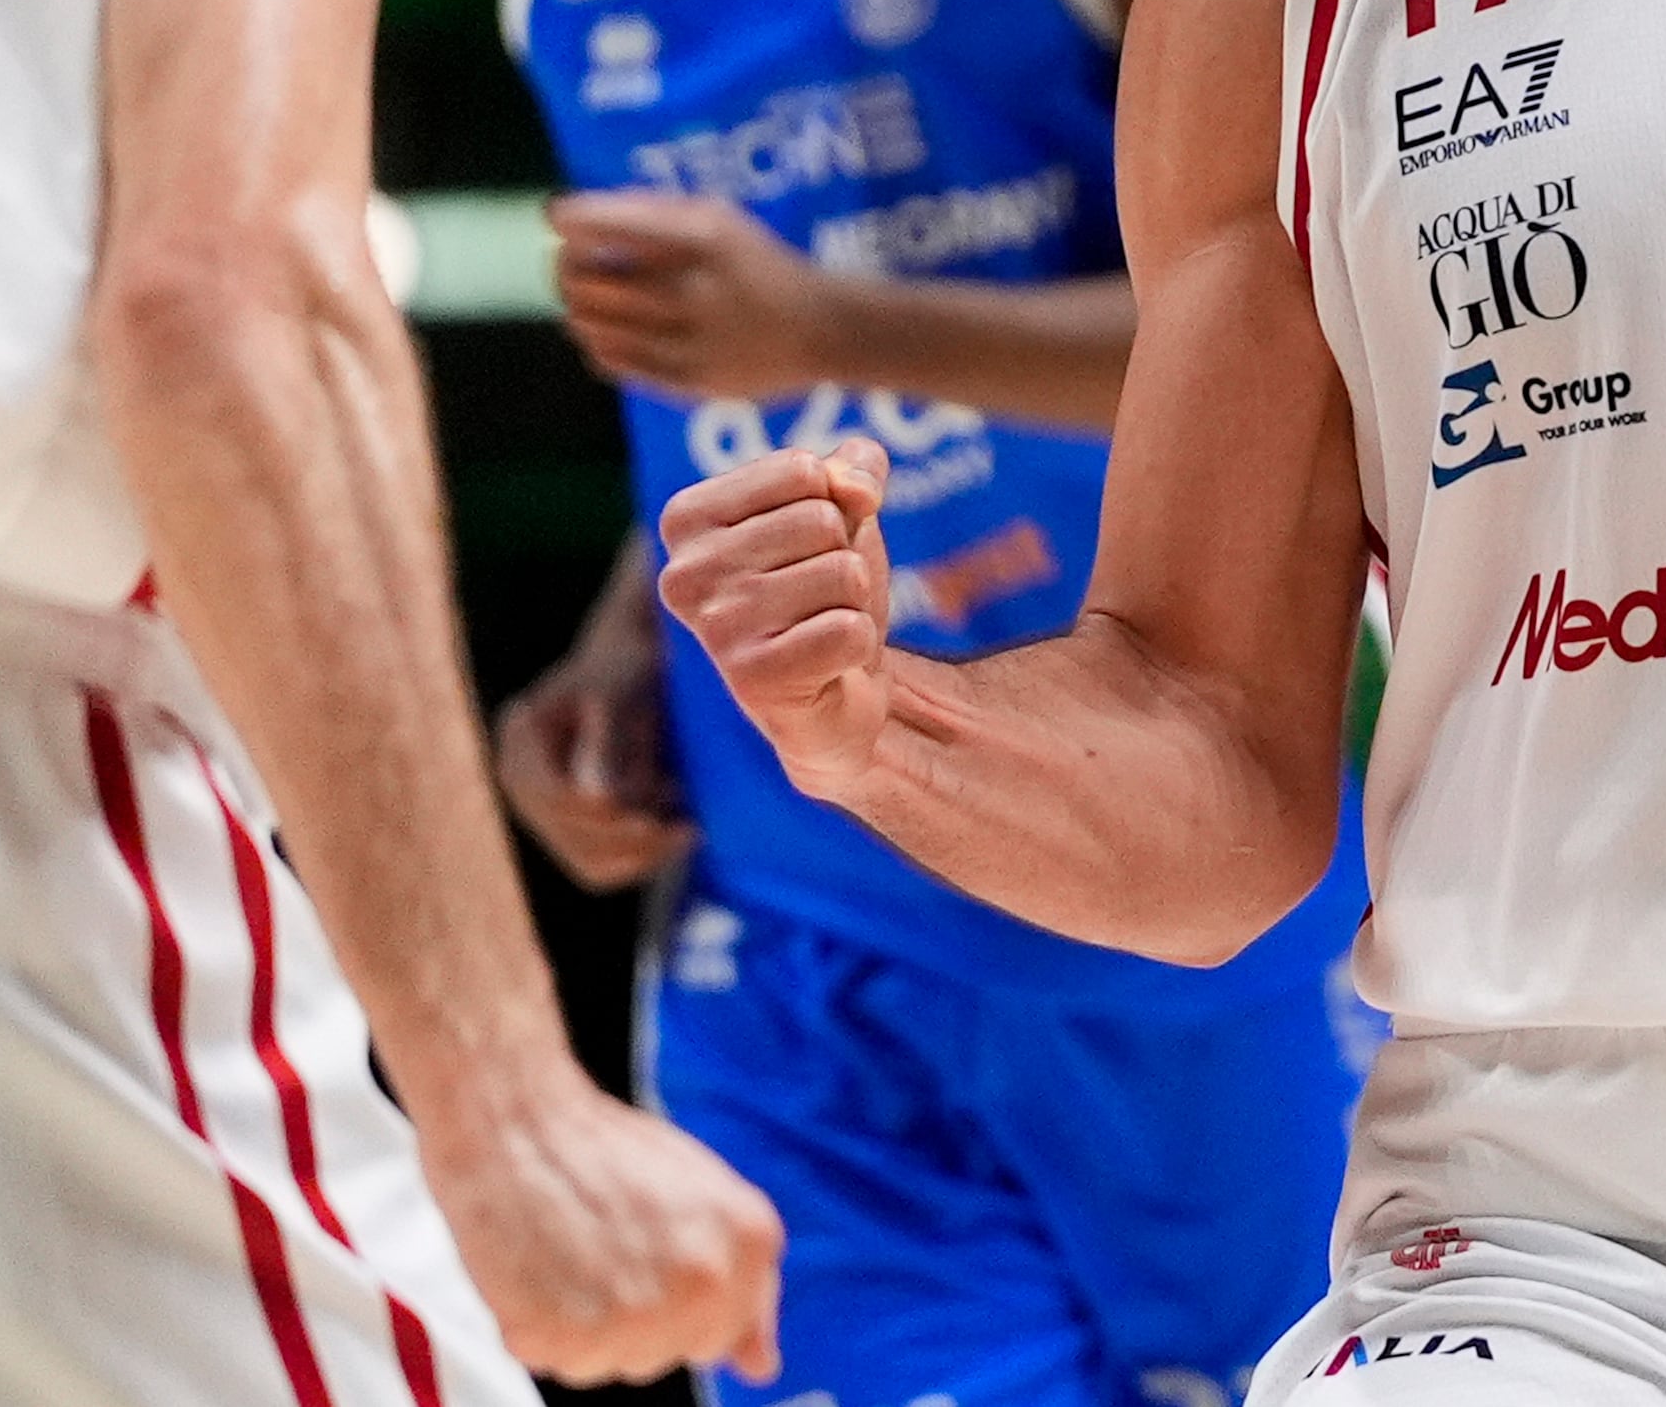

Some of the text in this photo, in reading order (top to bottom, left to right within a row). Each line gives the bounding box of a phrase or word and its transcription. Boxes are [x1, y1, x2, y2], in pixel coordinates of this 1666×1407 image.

[1395, 39, 1565, 152] EA7
[1399, 108, 1571, 177] EMPORIO ARMANI
[1417, 176, 1579, 260] ACQUA DI
[1522, 371, 1632, 414] Group
